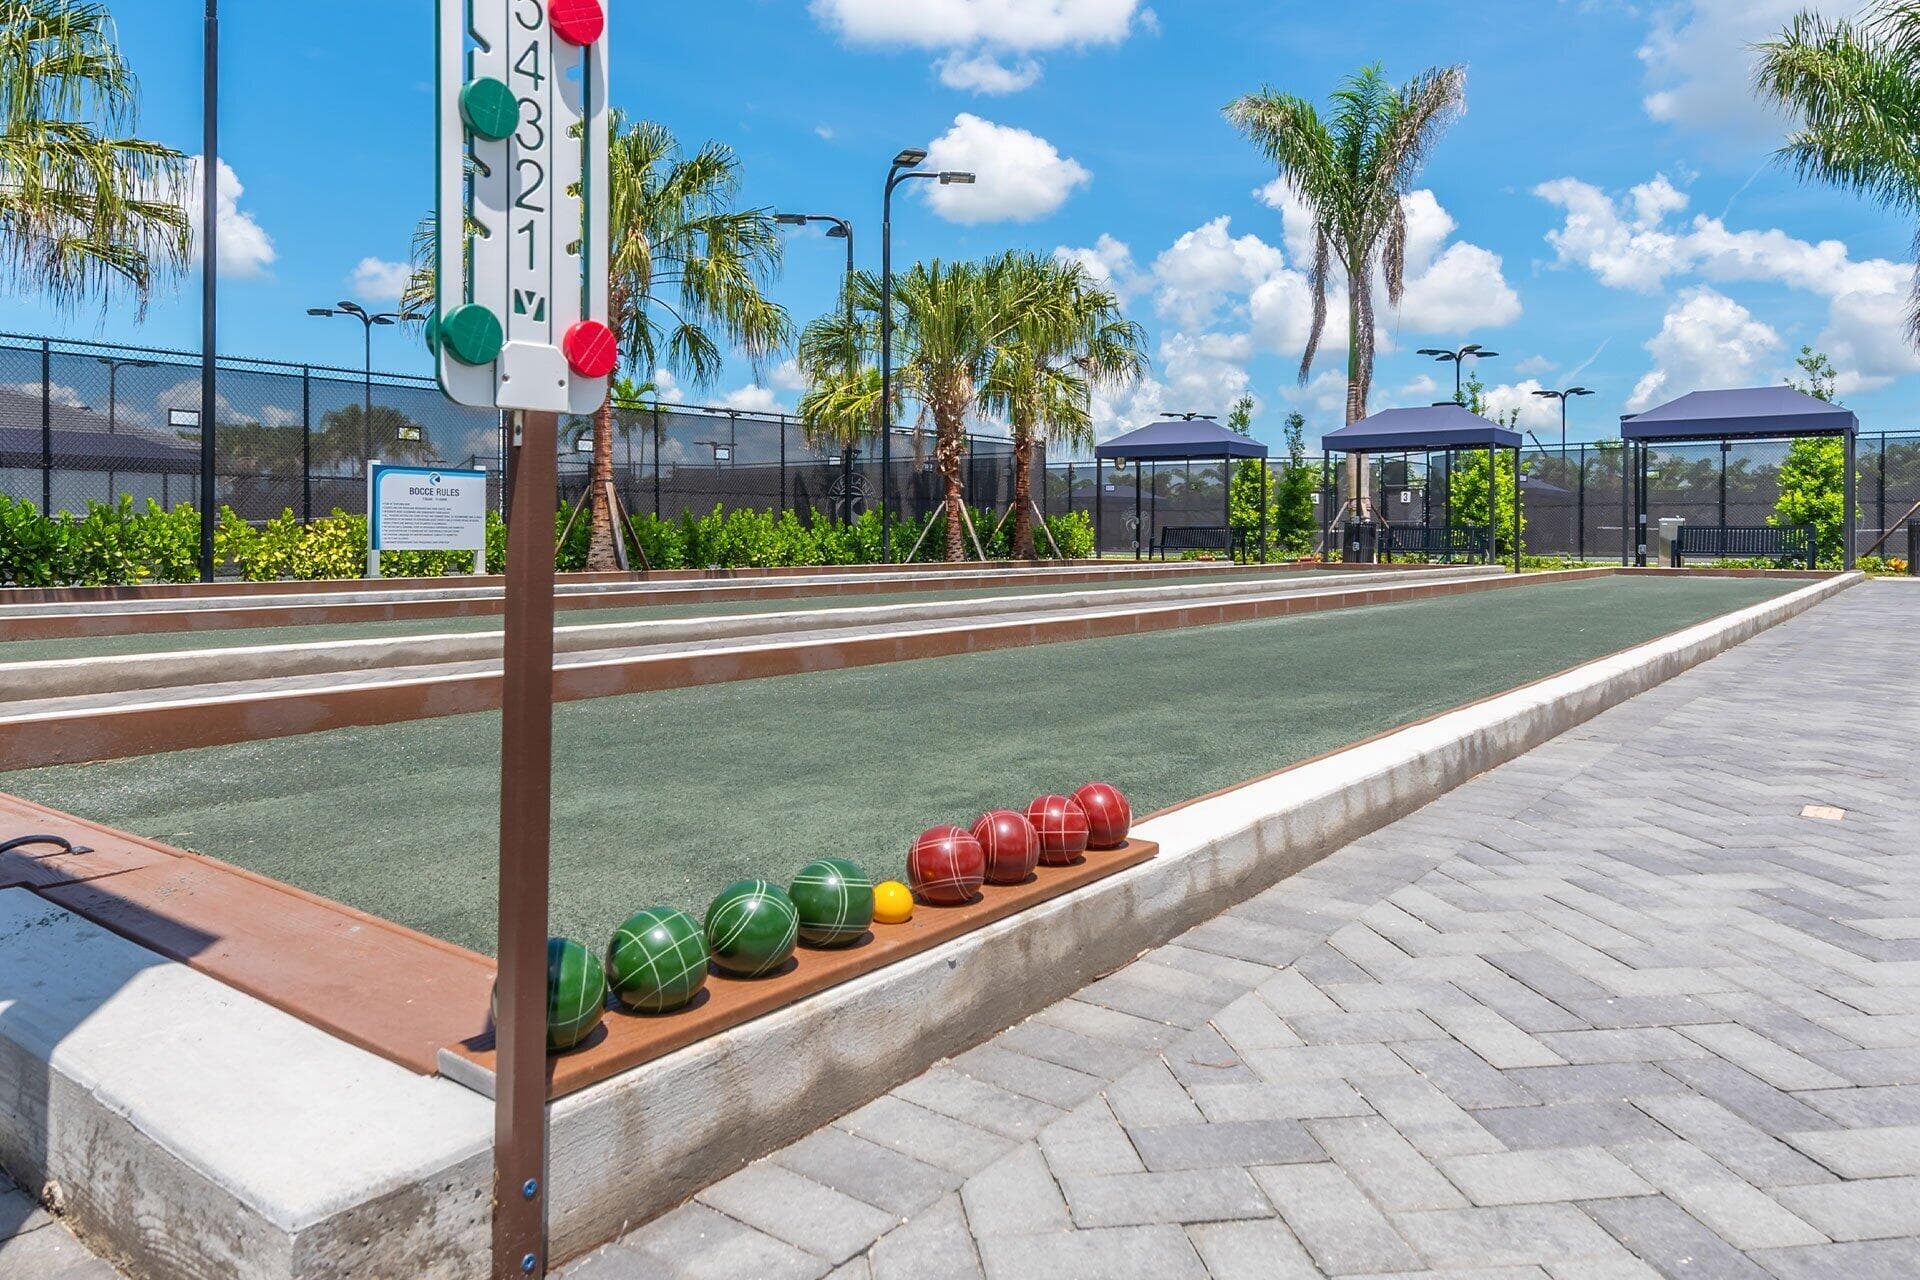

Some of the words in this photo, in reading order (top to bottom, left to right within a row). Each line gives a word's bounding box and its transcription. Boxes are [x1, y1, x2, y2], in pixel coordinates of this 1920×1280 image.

[514, 40, 545, 91] 4
[515, 97, 544, 151] 3
[515, 158, 545, 213] 2
[517, 219, 534, 271] 1
[409, 487, 434, 496] BOCCE
[436, 488, 460, 497] RULES
[1403, 492, 1408, 502] 3
